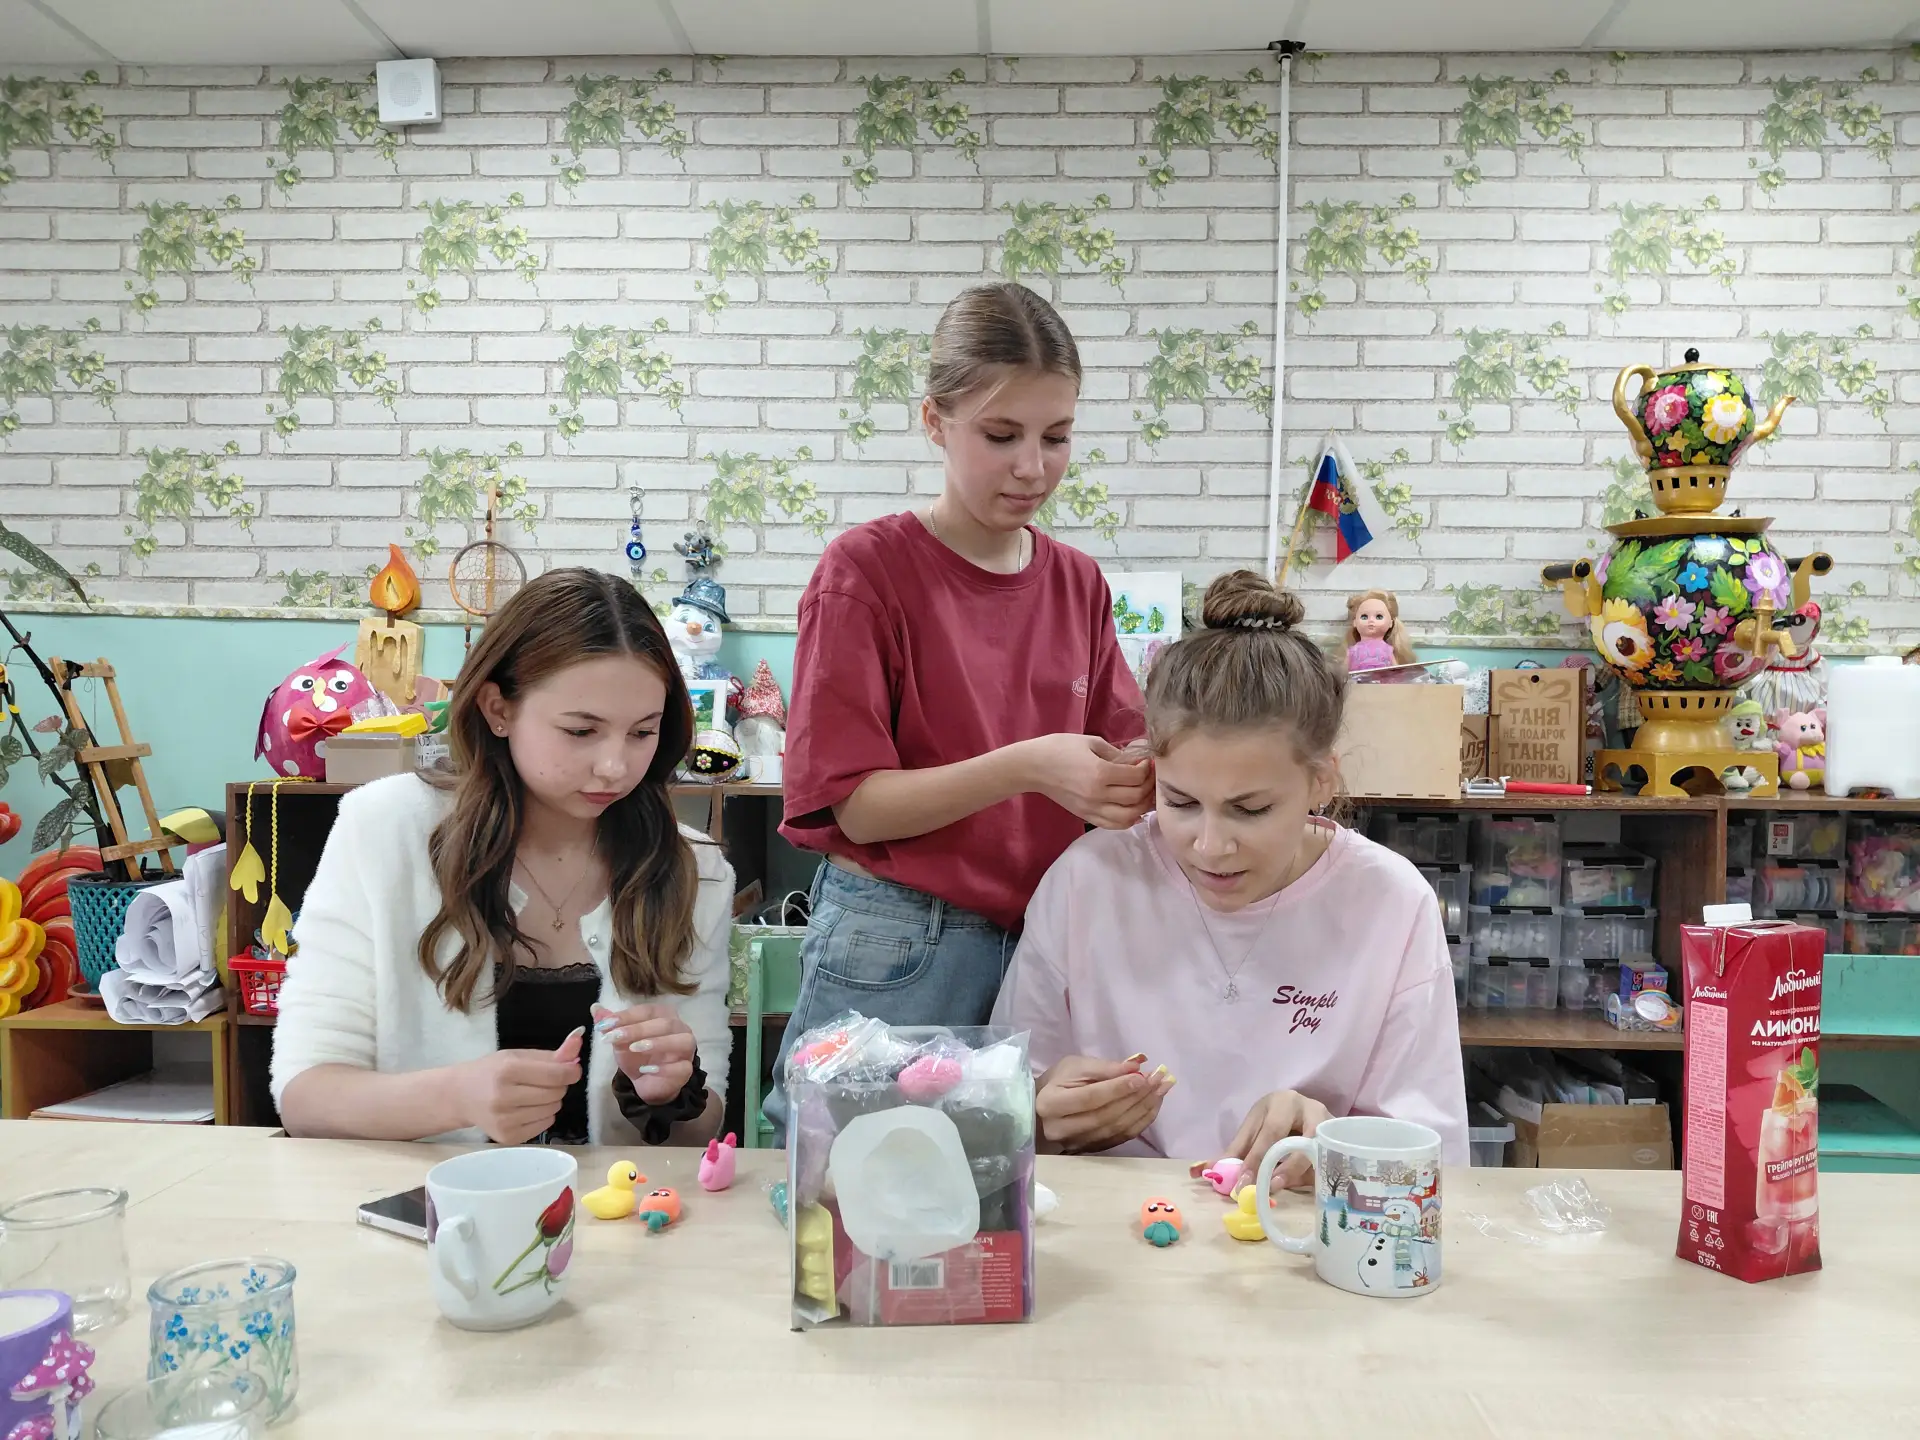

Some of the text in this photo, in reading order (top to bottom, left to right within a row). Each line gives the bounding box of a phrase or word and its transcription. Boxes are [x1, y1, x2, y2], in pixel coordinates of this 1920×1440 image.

[1509, 707, 1561, 726] ТАНЯ
[1503, 728, 1566, 740] НЕ ПОДАРОК
[1508, 742, 1560, 761] ТАНЯ
[1502, 763, 1566, 780] СЮРПРИЗ
[1692, 986, 1728, 999] Любимый
[1768, 969, 1821, 1001] Любимый
[1288, 1007, 1322, 1035] Joy
